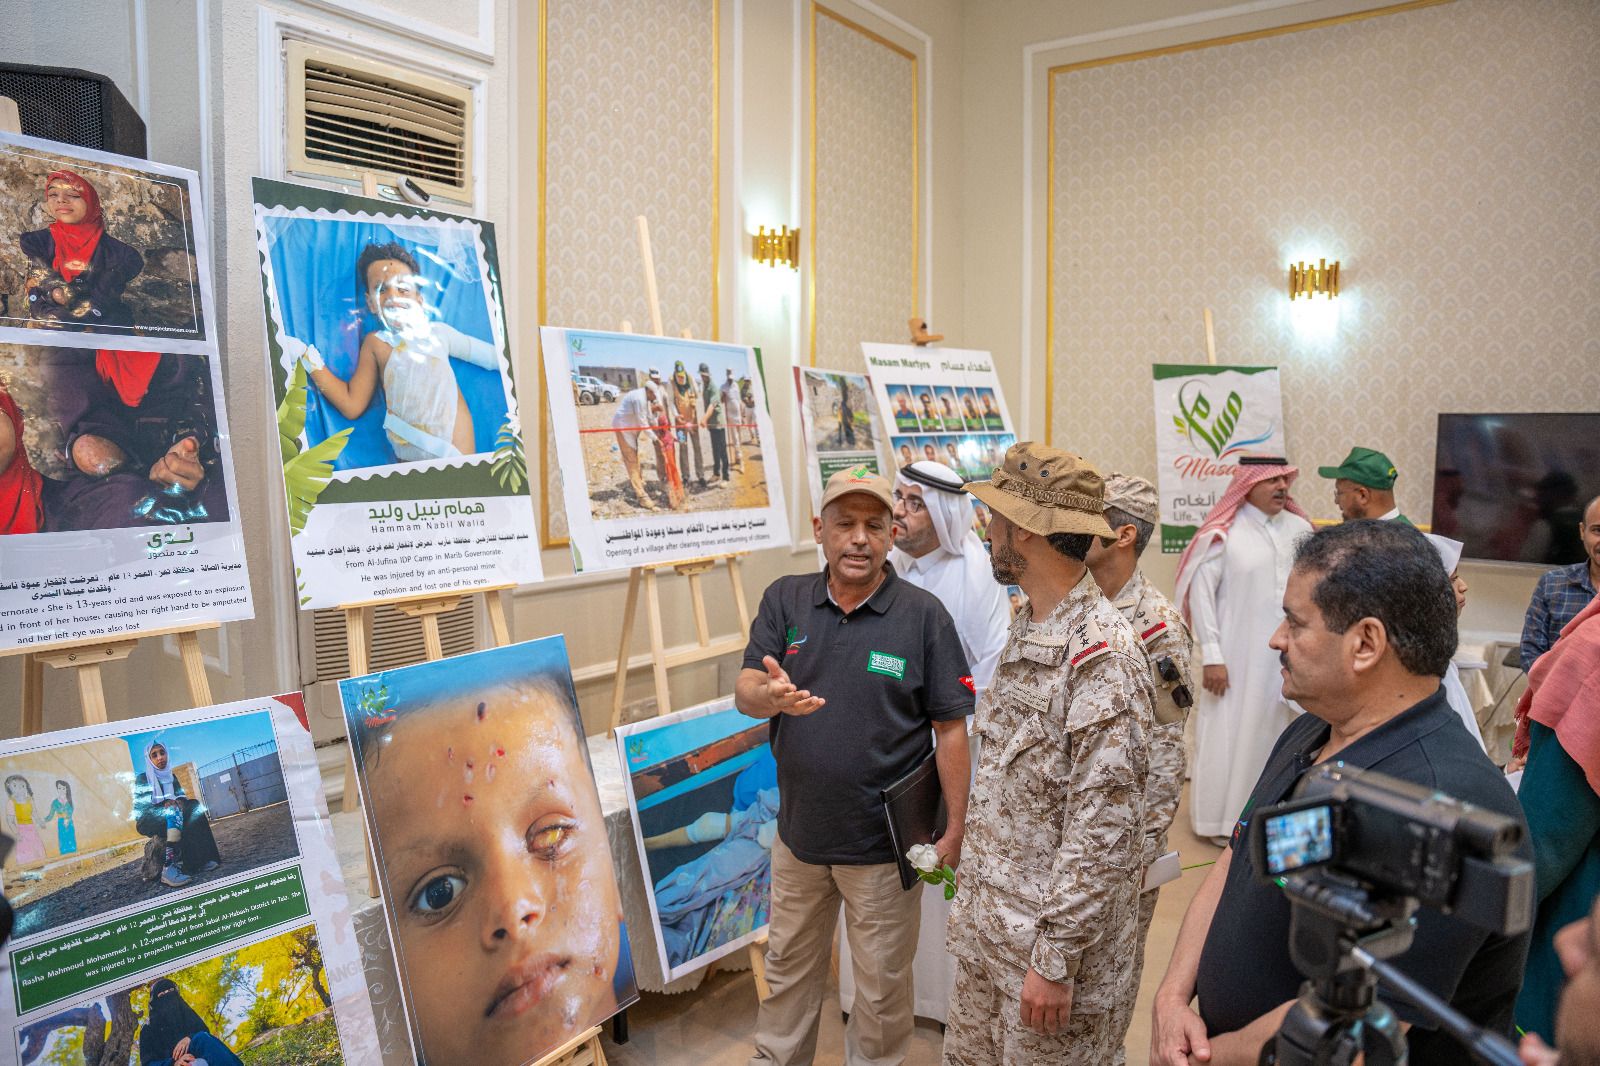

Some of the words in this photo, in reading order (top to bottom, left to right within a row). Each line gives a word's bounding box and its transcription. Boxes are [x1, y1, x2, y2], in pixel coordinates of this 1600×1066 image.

[870, 356, 899, 366] Masam
[900, 358, 930, 370] Martyrs
[1174, 455, 1238, 481] Masa
[368, 504, 404, 523] وليد
[407, 500, 440, 520] نبيل
[444, 500, 485, 518] همام
[372, 524, 420, 533] Hammam
[426, 522, 453, 530] Nabil
[458, 520, 485, 528] Walid
[414, 554, 433, 562] Camp
[444, 552, 462, 560] Marib
[464, 549, 504, 558] Governorate.
[606, 548, 632, 558] Opening
[646, 544, 664, 554] village
[666, 542, 678, 550] after
[680, 540, 700, 548] clearing
[222, 562, 242, 570] مديرية
[390, 570, 414, 580] injured
[416, 569, 425, 578] by
[438, 564, 478, 574] anti-personal
[43, 576, 67, 588] لانفجار
[69, 575, 99, 584] تعرضت
[108, 573, 120, 582] عام
[0, 582, 18, 590] ناسف
[20, 581, 40, 590] عبوة
[64, 588, 84, 596] عينها
[88, 584, 112, 593] وفقدت
[374, 586, 406, 596] explosion
[410, 584, 422, 592] and
[76, 600, 112, 609] 13-years
[130, 594, 144, 603] and
[163, 590, 192, 600] exposed
[215, 585, 245, 594] explosion
[20, 620, 40, 629] front
[104, 611, 134, 620] causing
[152, 605, 168, 614] right
[172, 604, 188, 612] hand
[212, 597, 247, 607] amputated
[18, 636, 34, 644] and
[54, 631, 68, 640] left
[72, 630, 87, 638] eye
[126, 622, 140, 631] lost
[22, 975, 44, 988] Rasha
[47, 960, 85, 978] Mahmoud
[140, 930, 176, 947] 12-year-old
[178, 926, 188, 936] girl
[190, 922, 204, 931] from
[250, 900, 270, 911] District
[85, 968, 100, 978] was
[101, 958, 126, 973] injured
[127, 956, 136, 964] by
[144, 943, 174, 958] projectile
[174, 938, 188, 947] that
[190, 928, 220, 943] amputated
[222, 924, 232, 932] her
[232, 918, 247, 928] right
